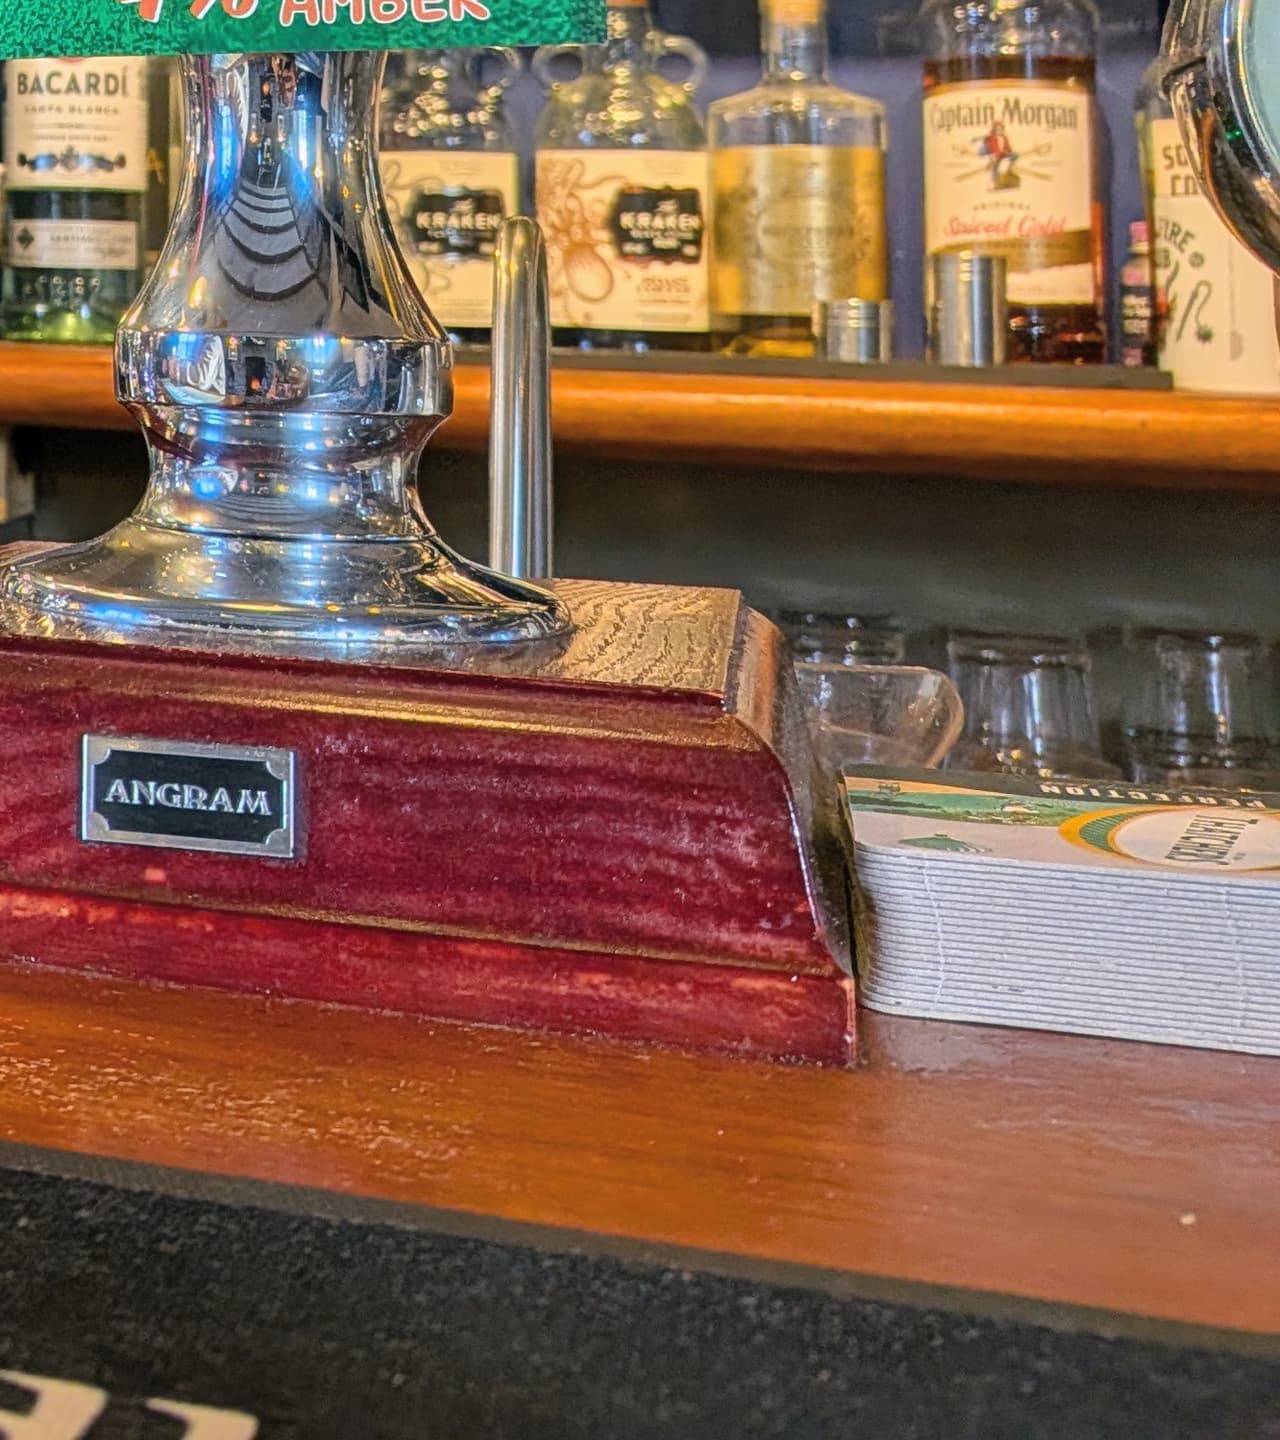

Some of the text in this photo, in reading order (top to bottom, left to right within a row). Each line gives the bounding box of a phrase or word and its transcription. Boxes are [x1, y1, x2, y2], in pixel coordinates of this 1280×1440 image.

[17, 65, 129, 96] BACARDÍ
[929, 97, 1078, 137] Captain Morgan
[416, 212, 501, 231] KRAKEN
[619, 212, 701, 232] KRAKEN
[104, 778, 272, 816] ANGRAM
[1040, 783, 1267, 809] PERFECTION
